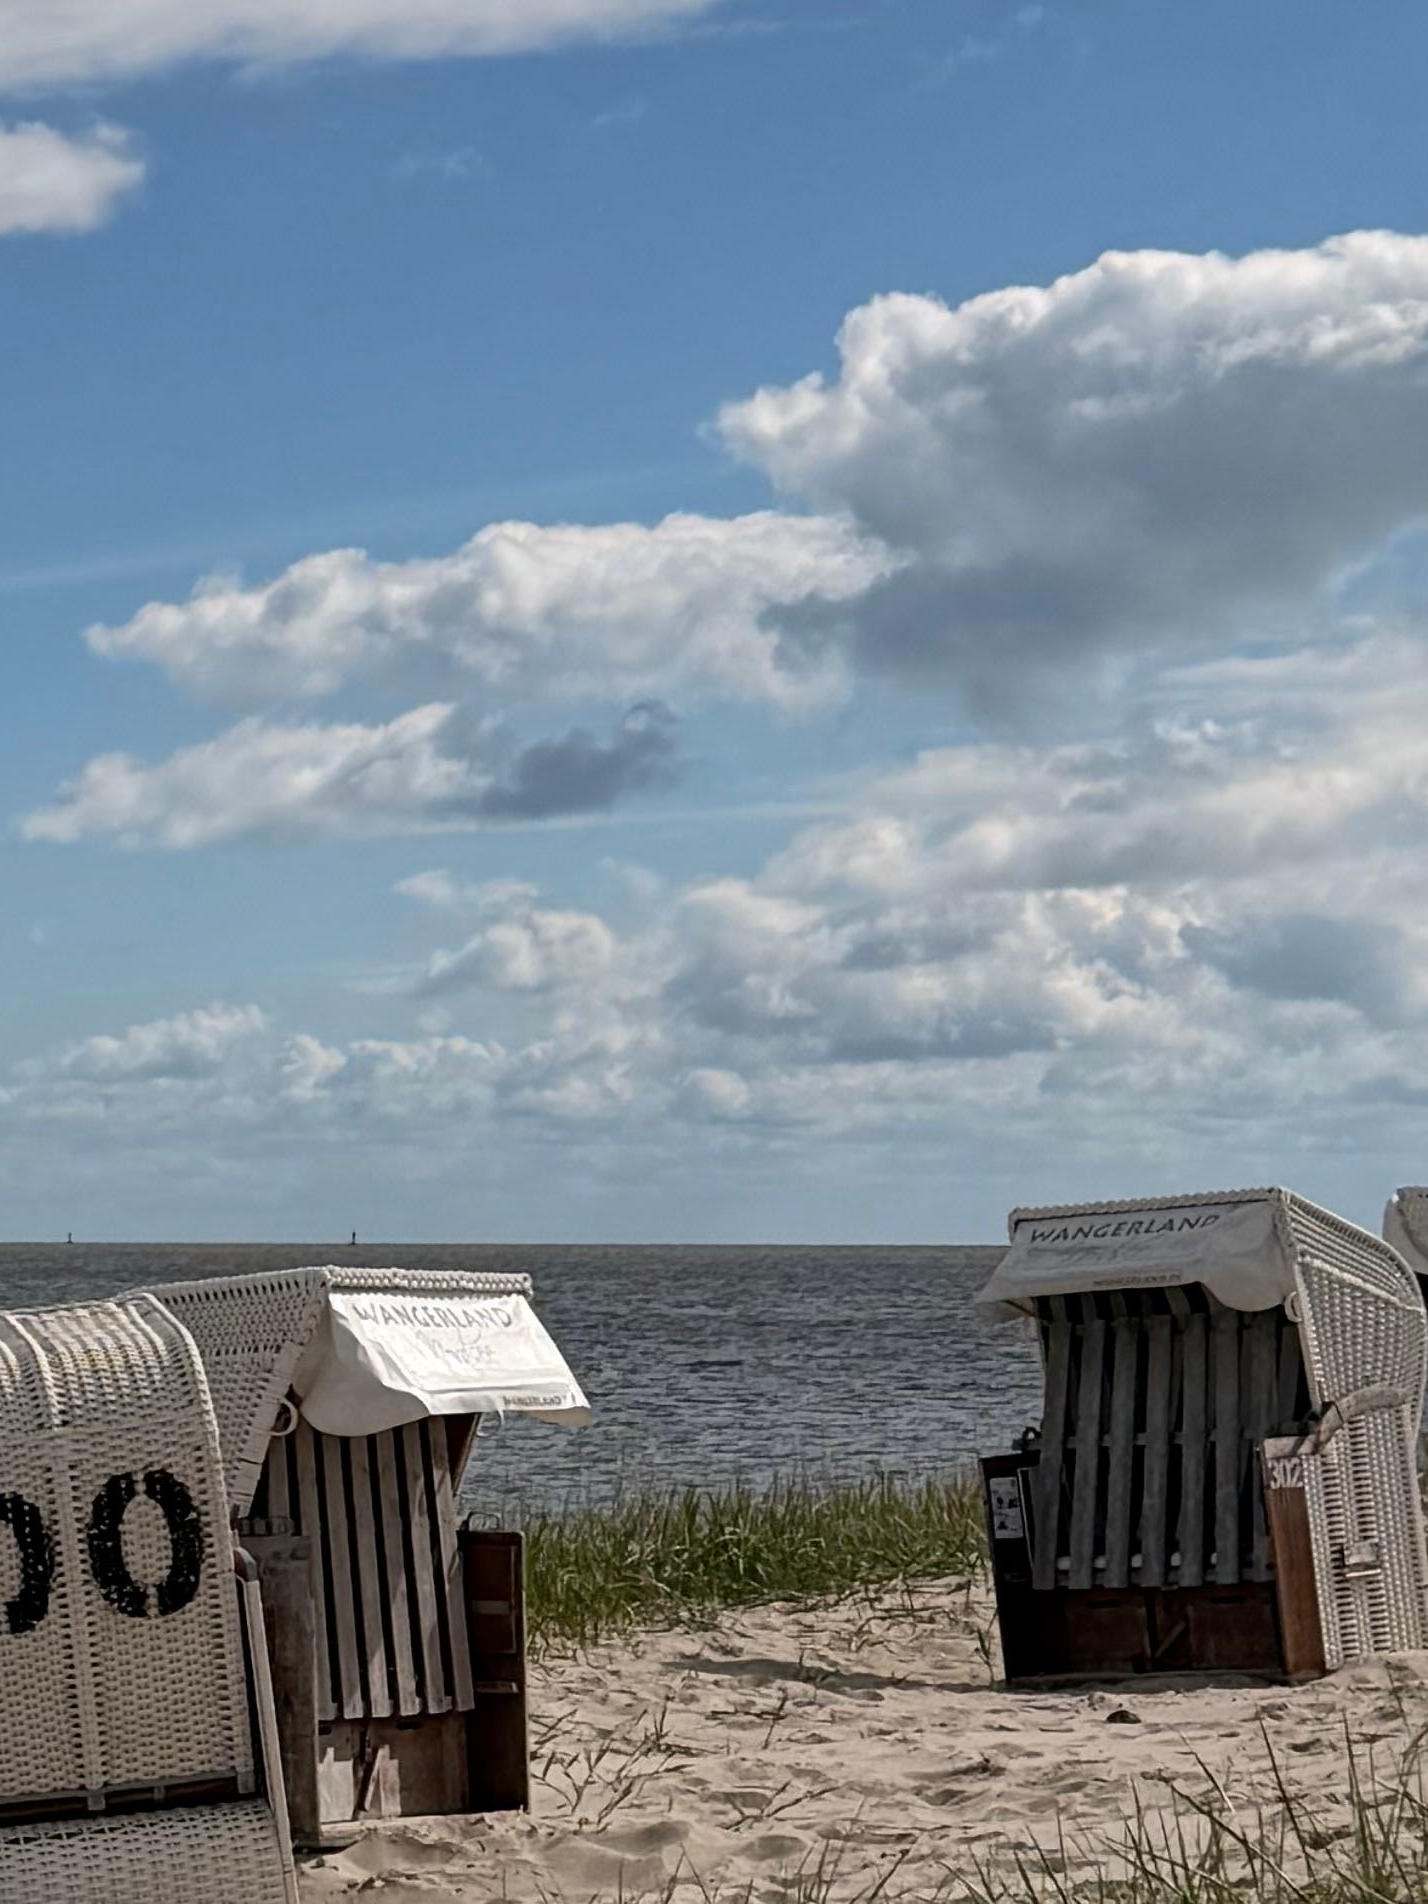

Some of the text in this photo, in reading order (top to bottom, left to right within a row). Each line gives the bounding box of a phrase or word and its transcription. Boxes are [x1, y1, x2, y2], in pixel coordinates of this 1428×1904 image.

[1029, 1214, 1220, 1244] WANGERLAND
[351, 1303, 513, 1329] WANGERLAND
[1267, 1456, 1304, 1490] 302
